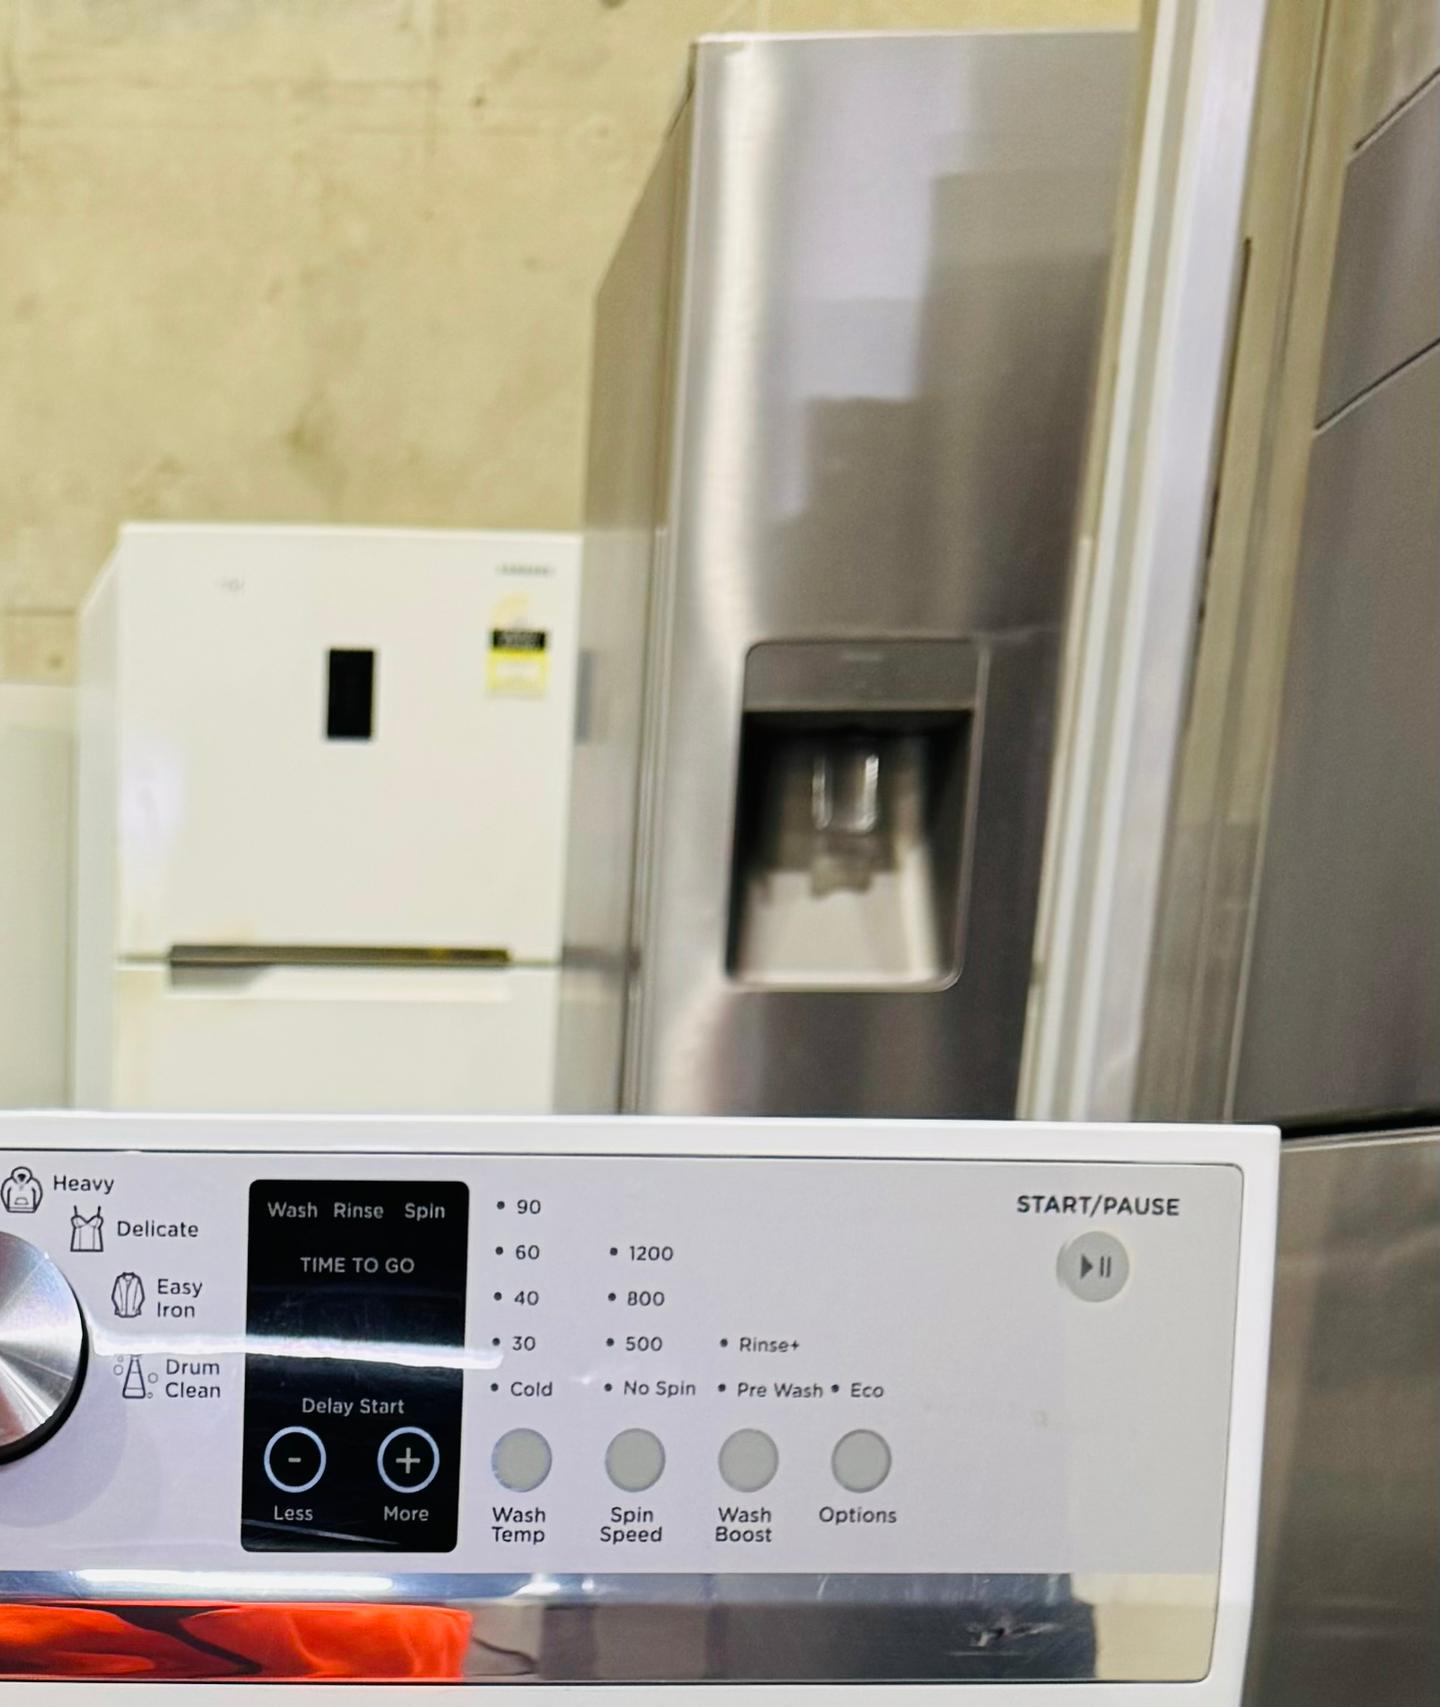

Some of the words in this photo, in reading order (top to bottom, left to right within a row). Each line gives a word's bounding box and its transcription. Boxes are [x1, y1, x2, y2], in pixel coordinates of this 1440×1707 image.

[53, 1175, 115, 1196] Heavy
[267, 1201, 318, 1218] Wash
[333, 1201, 384, 1219] Rinse
[404, 1202, 446, 1222] Spin
[516, 1199, 542, 1215] 90
[1017, 1194, 1180, 1217] START/PAUSE
[117, 1220, 199, 1238] Delicate
[515, 1244, 540, 1260] 60
[629, 1245, 674, 1262] 1200
[300, 1256, 346, 1273] TIME
[351, 1257, 379, 1274] TO
[385, 1257, 415, 1274] GO
[157, 1278, 203, 1299] Easy
[514, 1290, 540, 1306] 40
[627, 1290, 665, 1307] 800
[157, 1301, 197, 1319] Iron
[512, 1335, 536, 1352] 30
[625, 1336, 663, 1352] 500
[739, 1336, 800, 1353] Rinse+
[166, 1358, 220, 1376] Drum
[165, 1381, 221, 1399] Clean
[510, 1381, 553, 1397] Cold
[623, 1380, 650, 1396] No
[655, 1380, 696, 1398] Spin
[737, 1381, 767, 1398] Pre
[773, 1382, 824, 1399] Wash
[850, 1382, 885, 1399] Eco
[302, 1397, 354, 1417] Delay
[359, 1398, 405, 1414] Start
[273, 1505, 314, 1521] Less
[383, 1505, 429, 1522] More
[492, 1506, 546, 1523] Wash
[609, 1506, 654, 1527] Spin
[718, 1506, 772, 1523] Wash
[818, 1505, 897, 1526] Options
[491, 1525, 545, 1545] Temp
[600, 1525, 663, 1546] Speed
[715, 1525, 772, 1543] Boost
